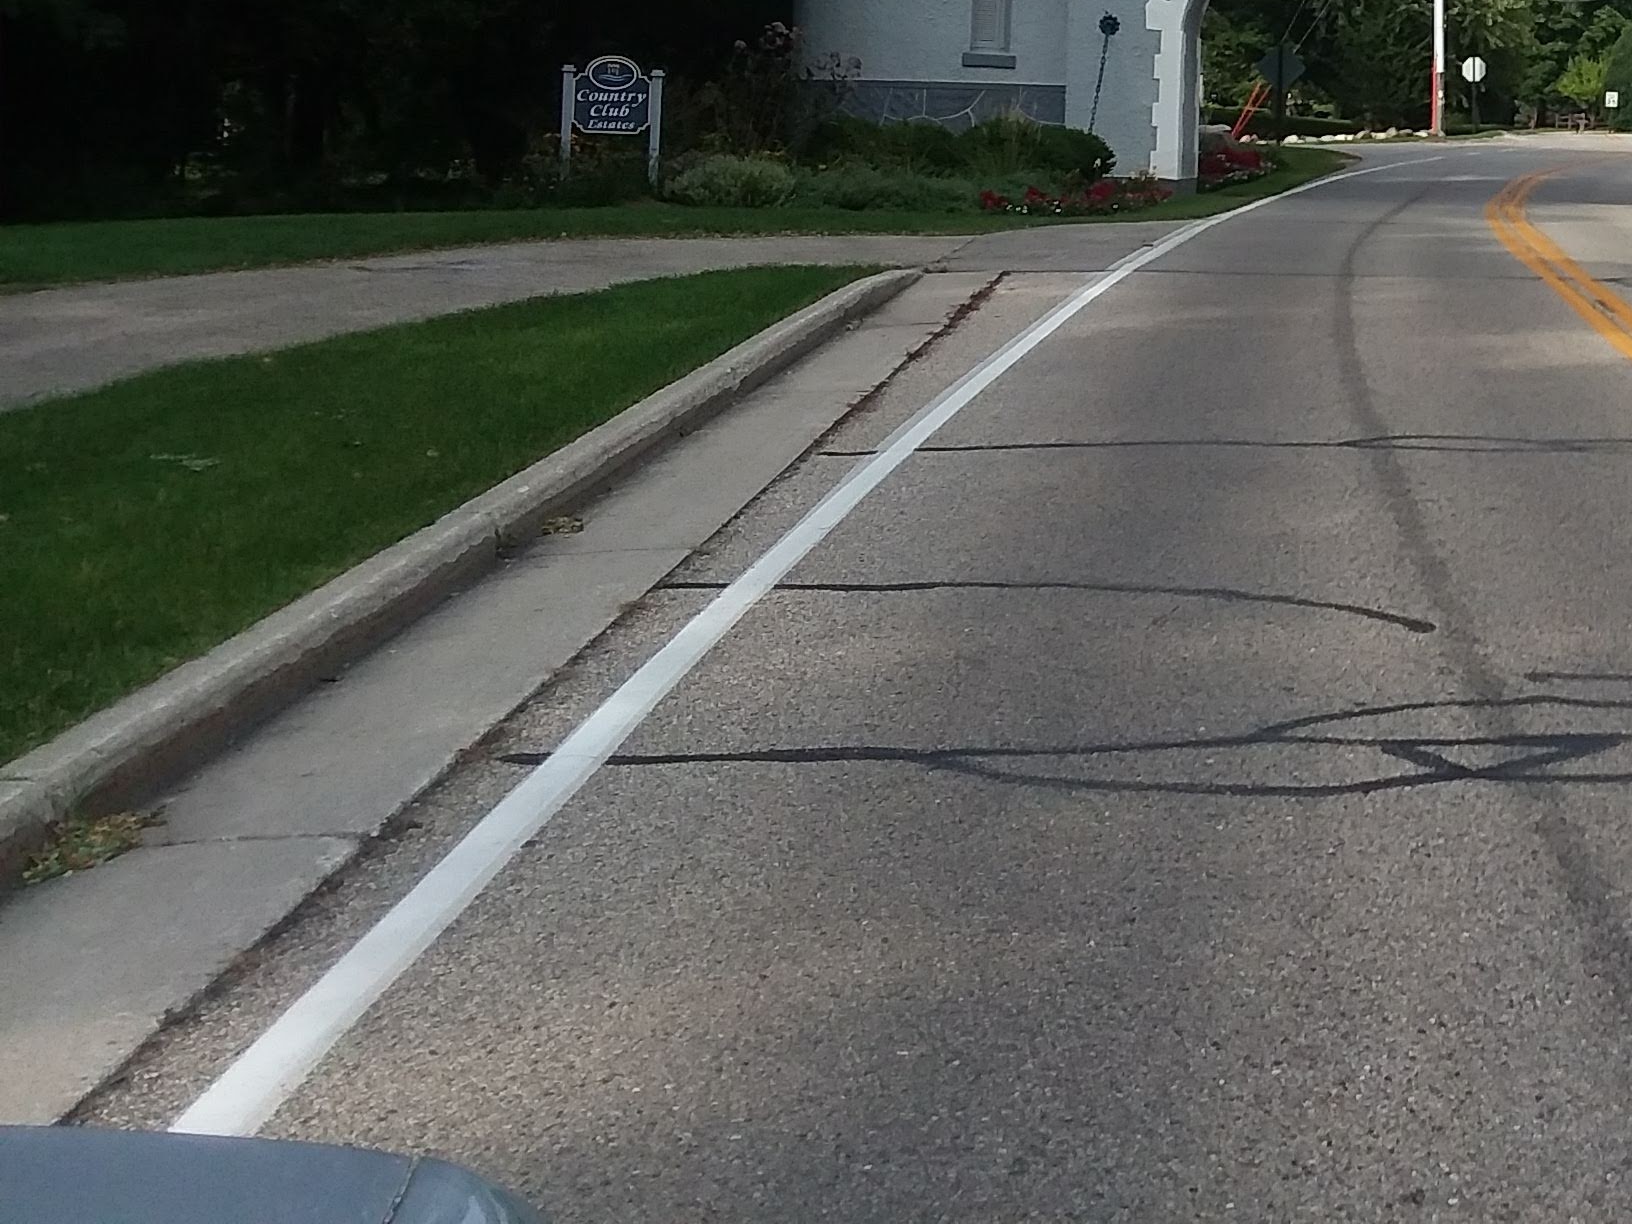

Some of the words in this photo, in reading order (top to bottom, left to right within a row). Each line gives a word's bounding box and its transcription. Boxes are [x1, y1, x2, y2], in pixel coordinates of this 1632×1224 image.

[577, 89, 647, 108] Country
[590, 103, 630, 117] Club
[588, 119, 636, 130] Estates
